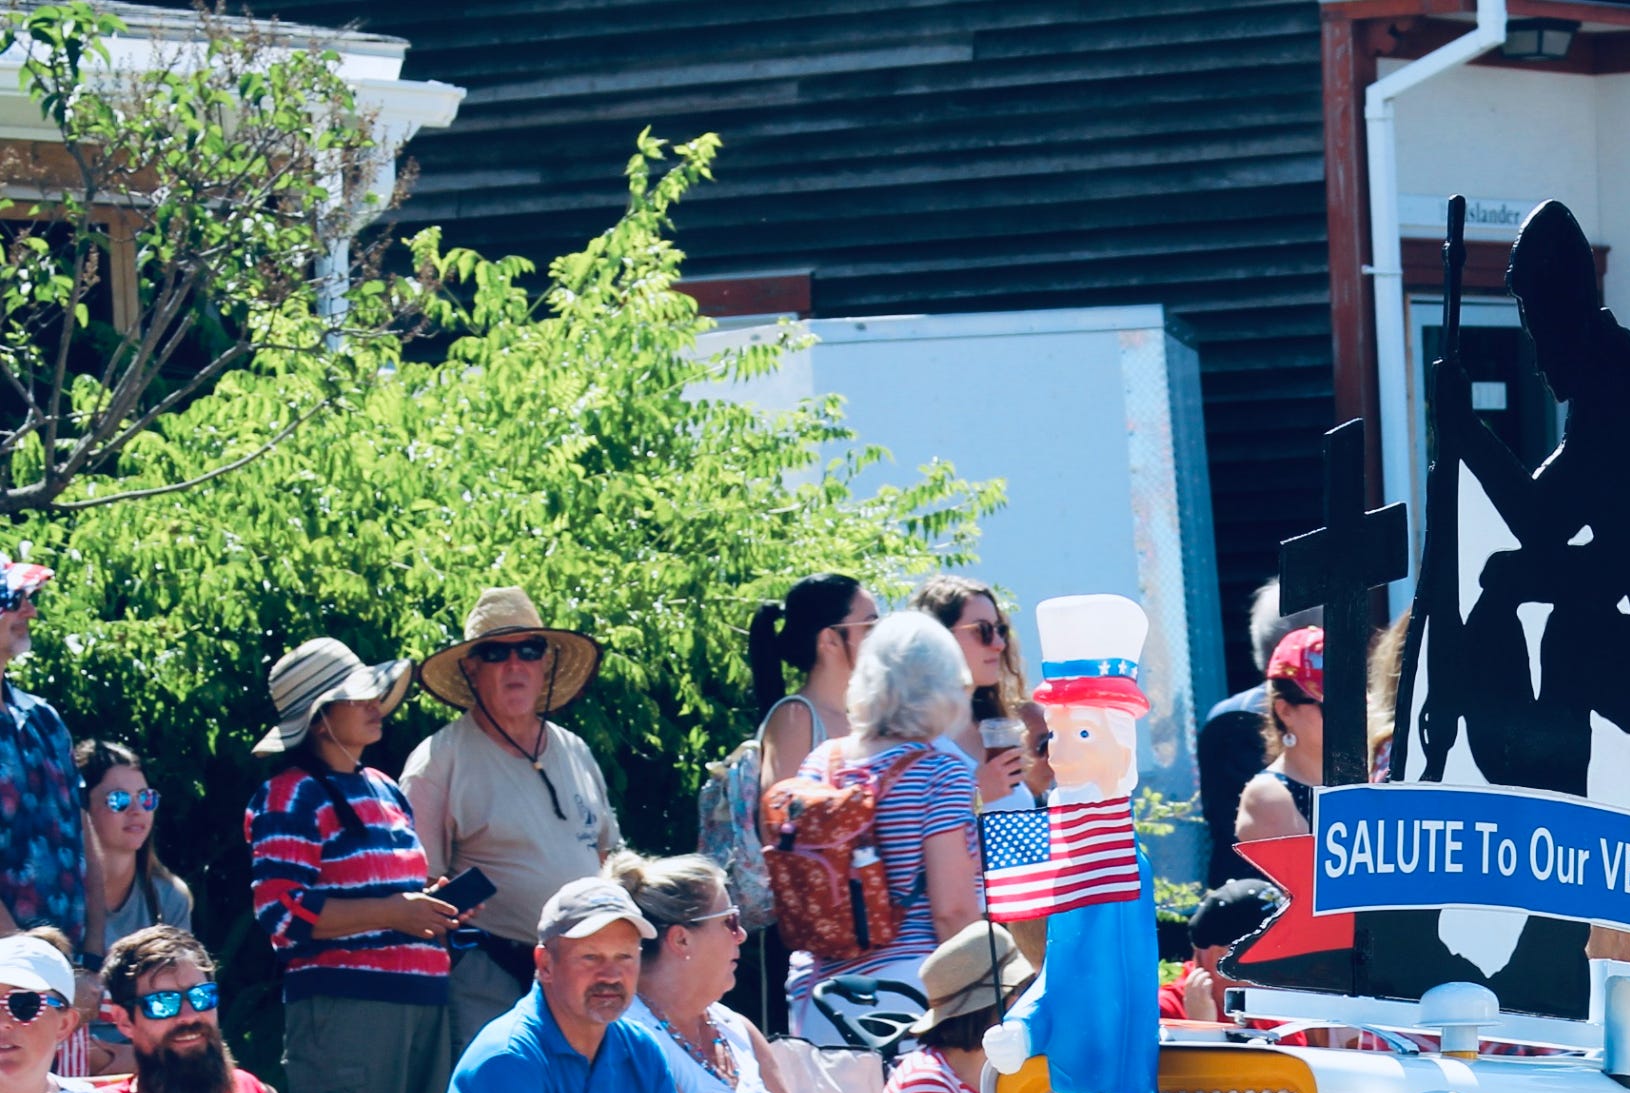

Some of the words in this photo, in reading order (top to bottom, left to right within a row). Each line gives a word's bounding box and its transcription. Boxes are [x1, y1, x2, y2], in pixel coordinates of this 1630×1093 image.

[1465, 202, 1521, 225] slander
[1324, 819, 1465, 878] SALUTE
[1475, 822, 1518, 877] To
[1529, 827, 1591, 886] Our
